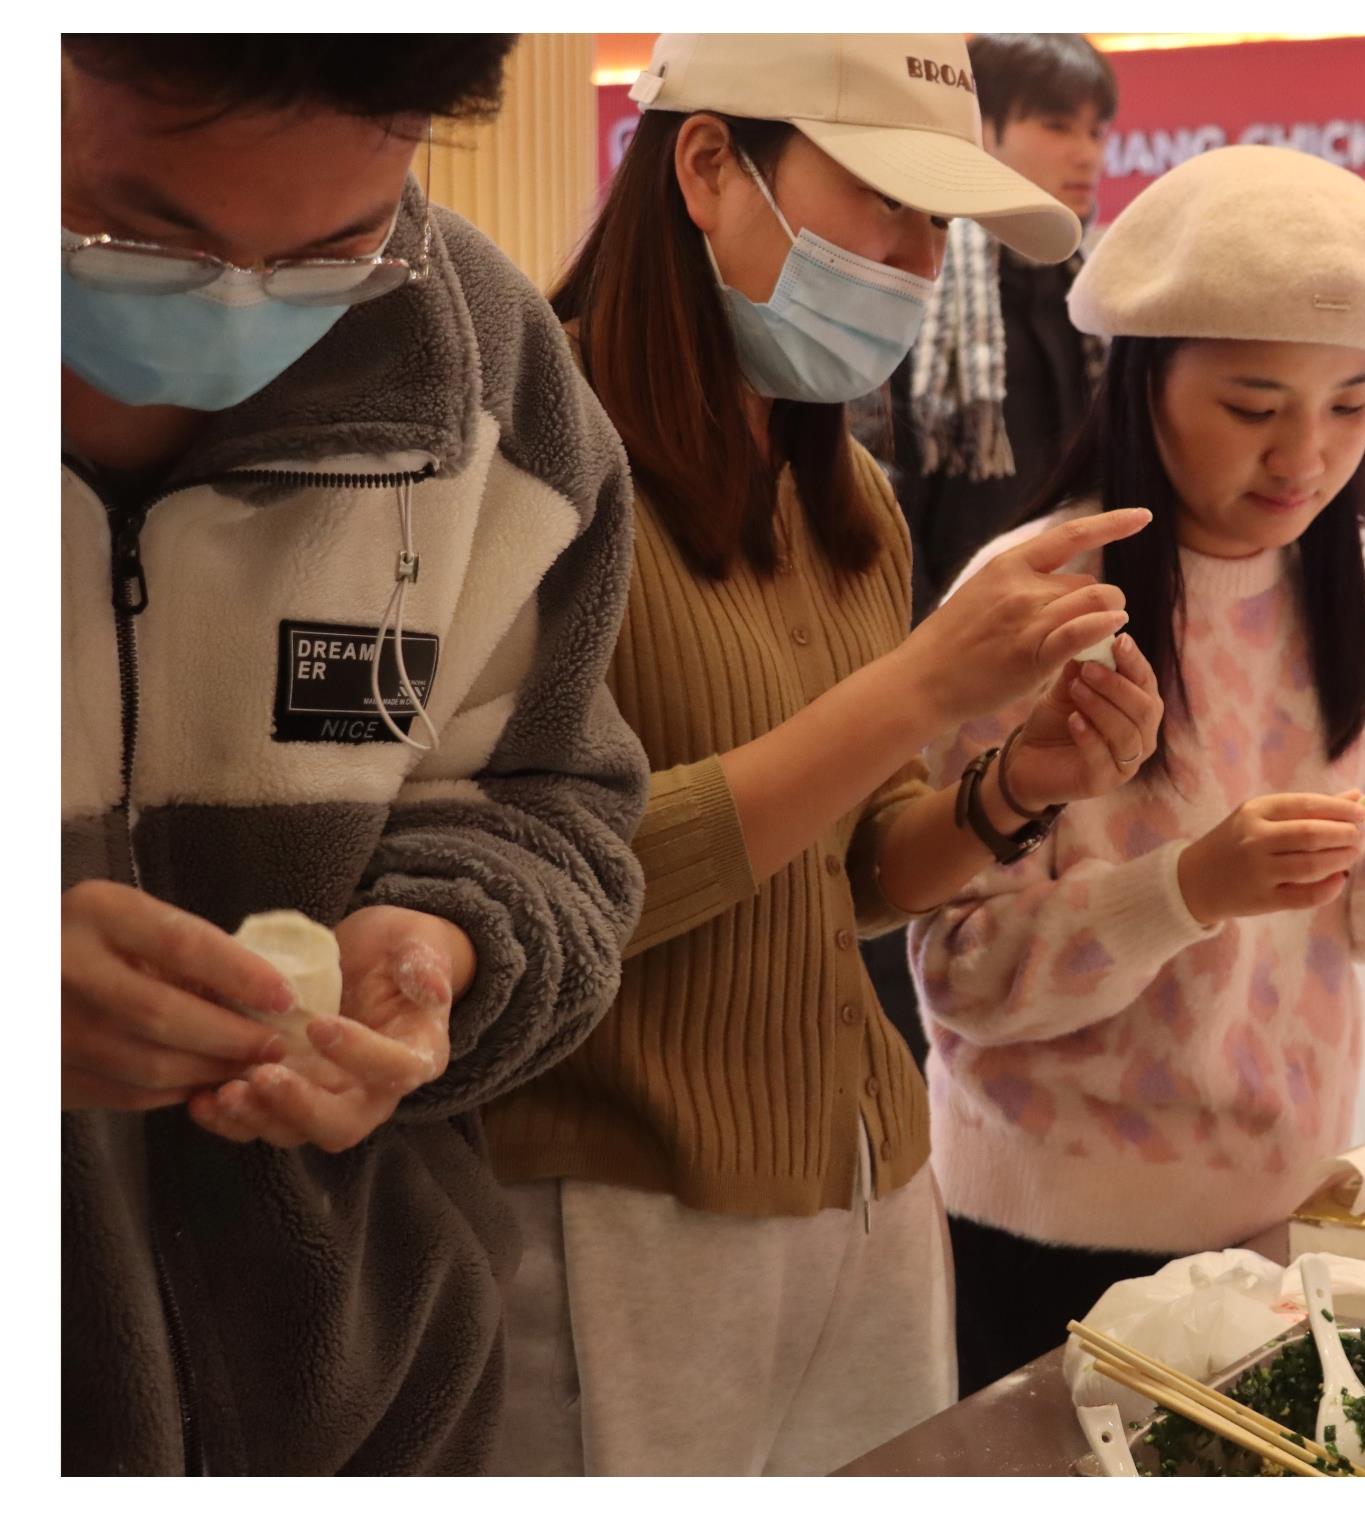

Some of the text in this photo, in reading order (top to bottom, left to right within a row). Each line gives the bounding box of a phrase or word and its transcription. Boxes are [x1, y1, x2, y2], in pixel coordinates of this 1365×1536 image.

[904, 56, 977, 95] BROA
[297, 639, 377, 662] DREAM
[297, 661, 328, 681] ER
[320, 719, 380, 740] NICE
